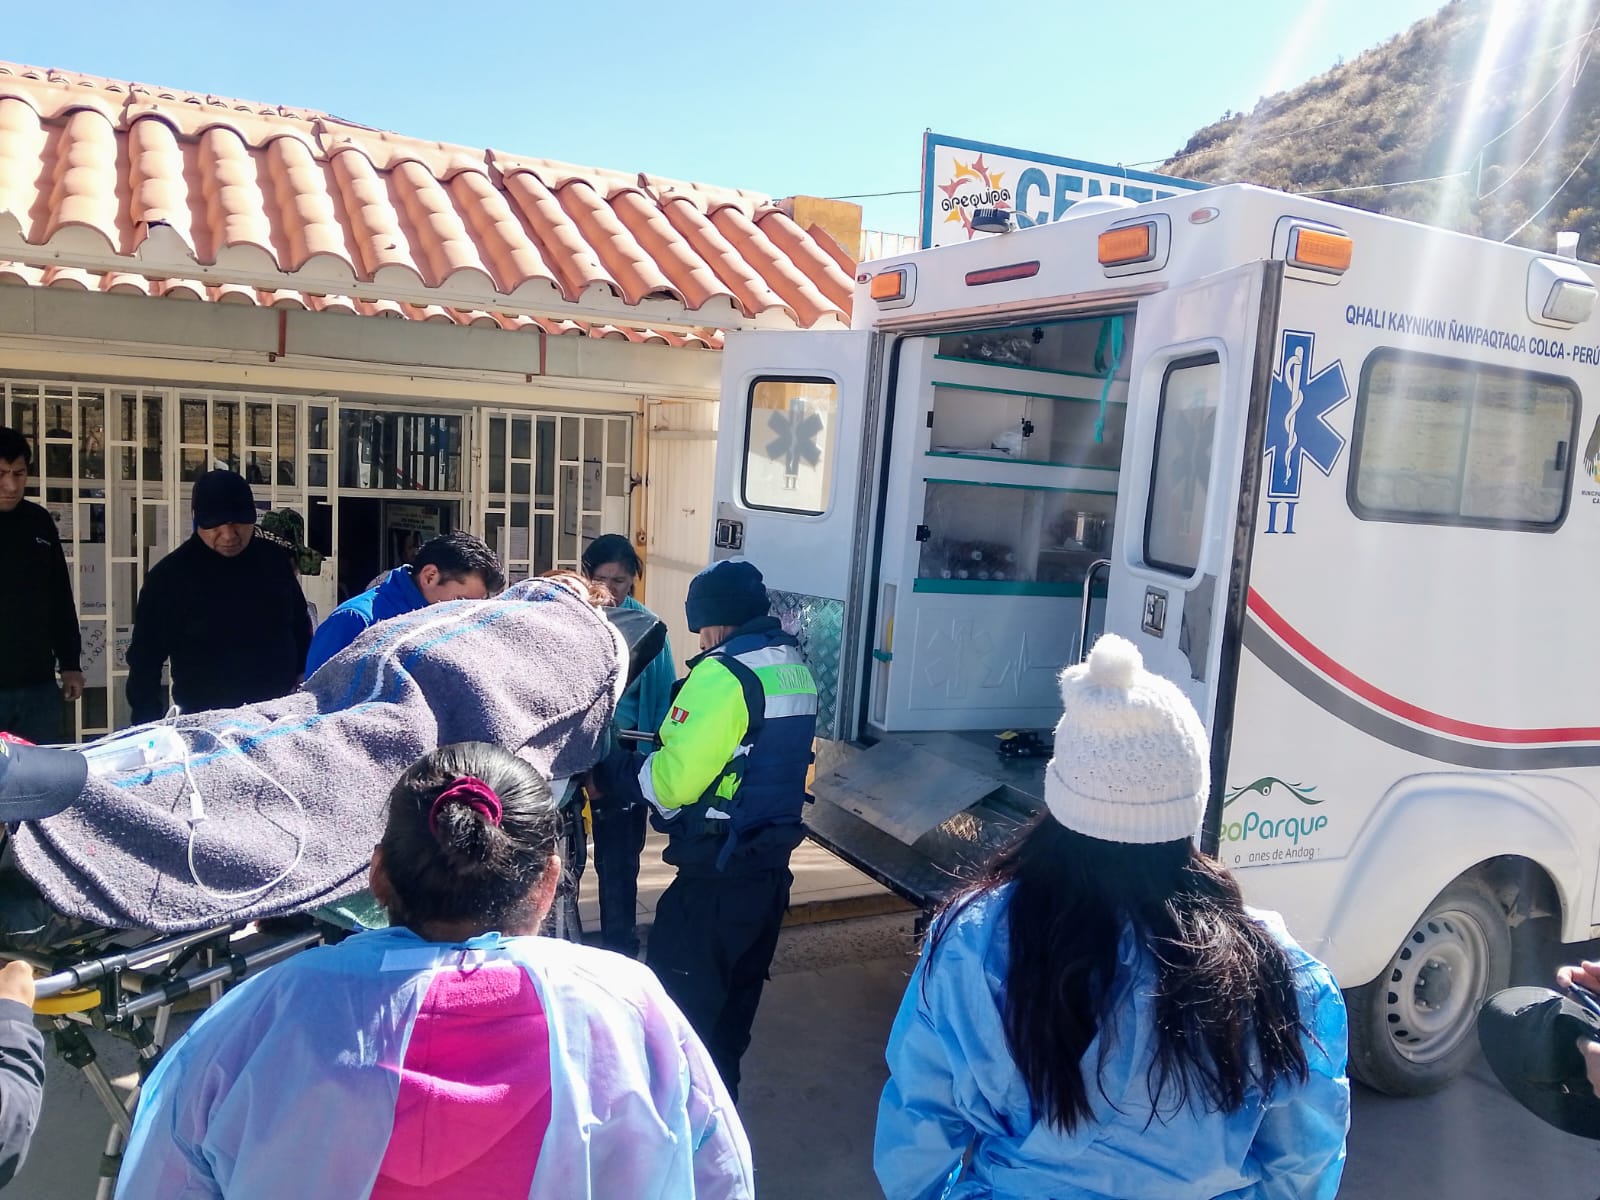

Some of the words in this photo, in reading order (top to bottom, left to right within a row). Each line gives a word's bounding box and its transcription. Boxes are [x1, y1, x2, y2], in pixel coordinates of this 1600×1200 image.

[941, 188, 1011, 212] arequipa
[1345, 304, 1386, 329] QHALI
[1387, 311, 1447, 340] KAYNIKIN
[1448, 319, 1527, 352] ÑAWPAQTAQA
[1528, 336, 1565, 359] COLCA
[1572, 344, 1600, 366] PERÚ
[1263, 501, 1299, 534] II
[1219, 811, 1328, 845] eoParque
[1272, 848, 1284, 861] de
